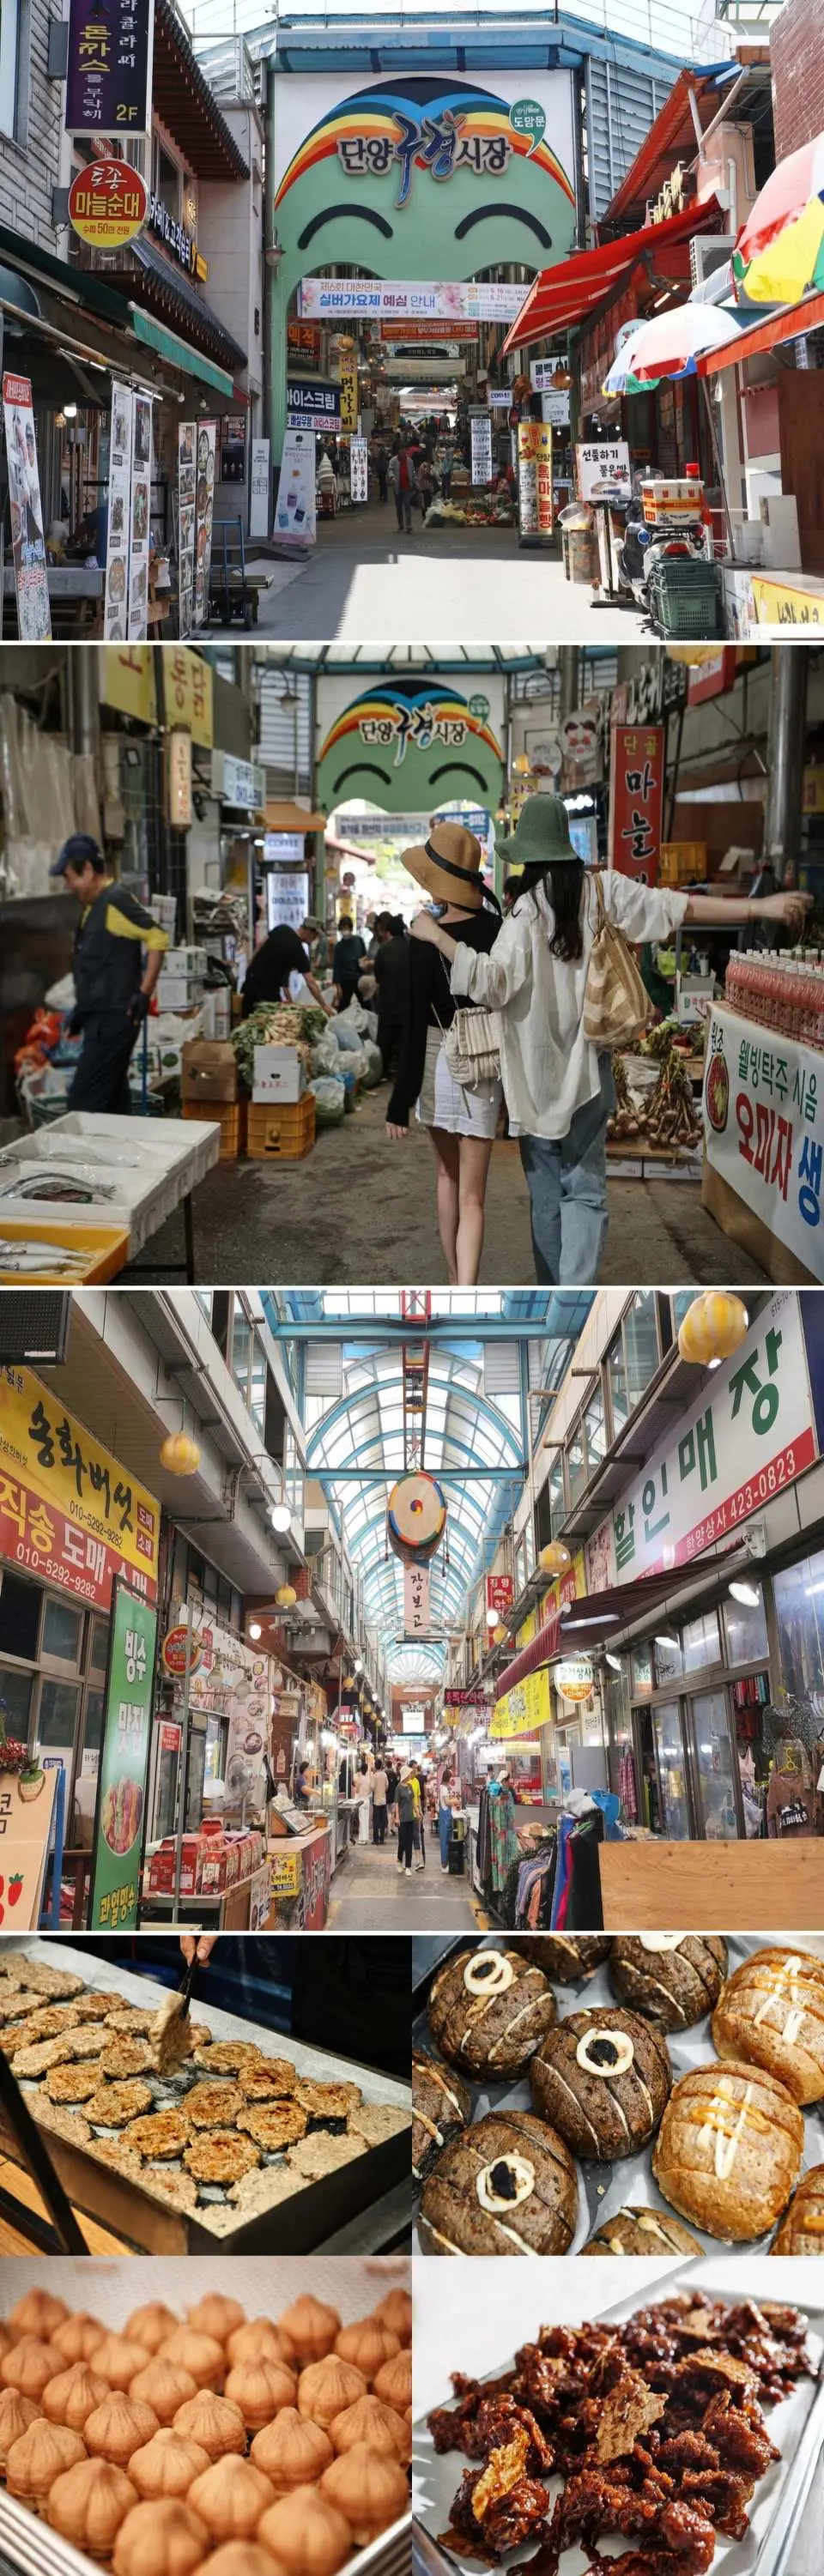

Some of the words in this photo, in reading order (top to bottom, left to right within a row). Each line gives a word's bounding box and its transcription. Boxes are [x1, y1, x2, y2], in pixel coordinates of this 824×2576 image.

[116, 104, 138, 121] 2F
[90, 166, 128, 190] 토종
[76, 191, 140, 217] 마늘순대
[320, 294, 380, 307] 실버가요제
[383, 294, 408, 307] 예심
[410, 295, 435, 308] 안내
[346, 282, 383, 293] 대한민국
[624, 734, 659, 756] 단골
[622, 761, 657, 886] 마늘
[711, 1020, 724, 1055] 원조
[737, 1038, 790, 1102] 웰빙탁주
[792, 1068, 818, 1123] 시음
[736, 1091, 793, 1202] 오미자
[798, 1134, 823, 1227] 생
[28, 1400, 134, 1534] 송화버섯
[730, 1448, 797, 1520] 423-0823
[70, 1498, 124, 1549] 010-5292-9282
[16, 1542, 96, 1600] 010-5292-9282
[409, 1573, 424, 1628] 장보고
[124, 1629, 148, 1684] 빙수
[99, 1882, 137, 1930] 과일빙수
